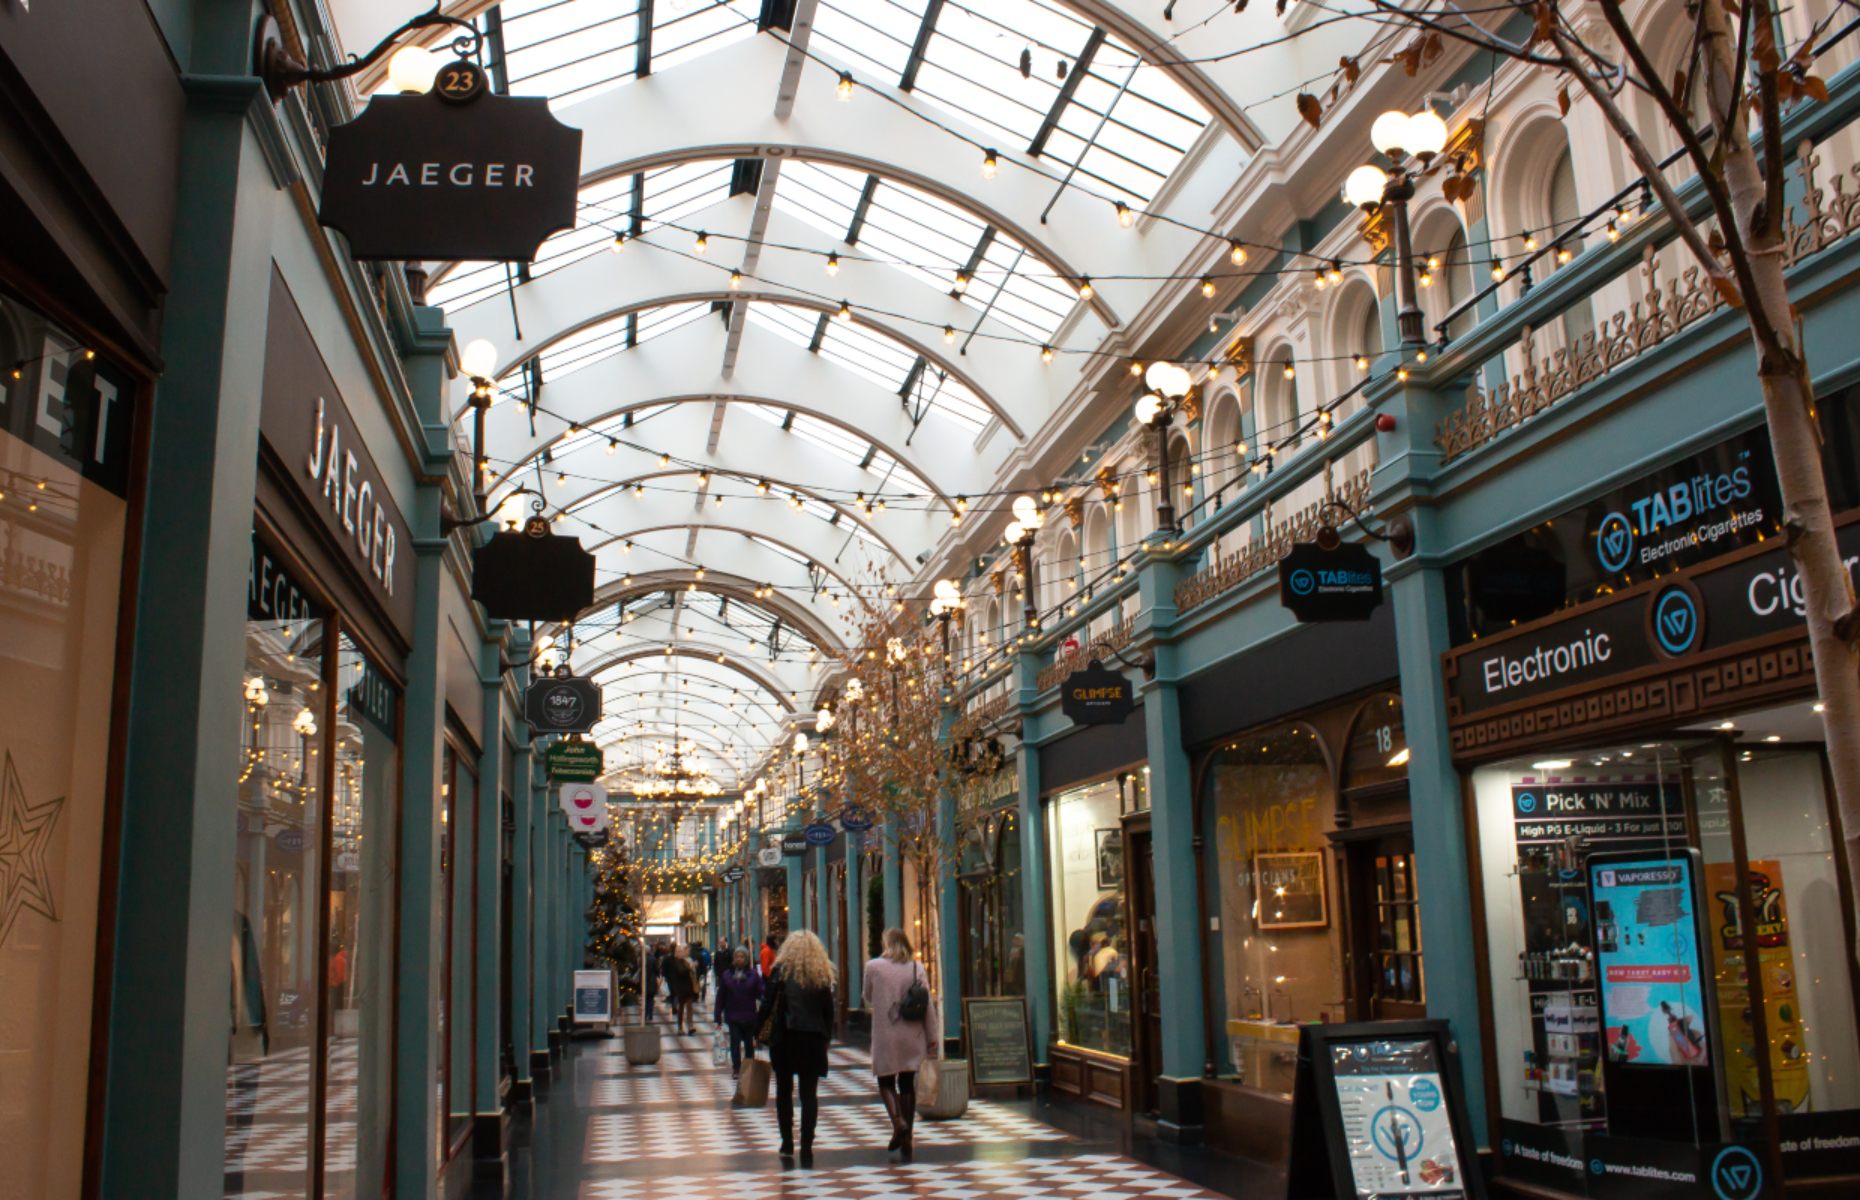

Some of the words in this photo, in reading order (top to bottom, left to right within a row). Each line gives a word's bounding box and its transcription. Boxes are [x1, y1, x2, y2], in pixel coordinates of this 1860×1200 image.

[445, 71, 474, 91] 23
[362, 162, 535, 187] JAEGER
[308, 396, 396, 597] JAEGER
[1631, 466, 1752, 537] TABlites
[530, 521, 545, 535] 25
[1640, 529, 1698, 564] Electronic
[1697, 508, 1764, 543] Cigarettes
[1317, 570, 1373, 585] TABlites
[1483, 628, 1612, 693] Electronic
[1072, 686, 1123, 700] GLIMPSE
[1376, 725, 1392, 753] 18
[1546, 793, 1587, 811] Pick
[1619, 792, 1651, 808] Mix
[1216, 797, 1315, 866] GLIMPSE
[1520, 825, 1546, 838] High
[1547, 825, 1562, 836] PG
[1564, 822, 1607, 837] E-Liquid
[1615, 822, 1622, 833] 3
[1624, 821, 1640, 832] For
[1642, 820, 1660, 832] just
[1238, 869, 1296, 887] OPTICIANS
[1618, 871, 1676, 882] VAPORESSO
[1514, 1143, 1521, 1154] A
[1521, 1146, 1540, 1160] taste
[1550, 1152, 1584, 1170] freedom
[1605, 1164, 1696, 1183] www.tablites.com
